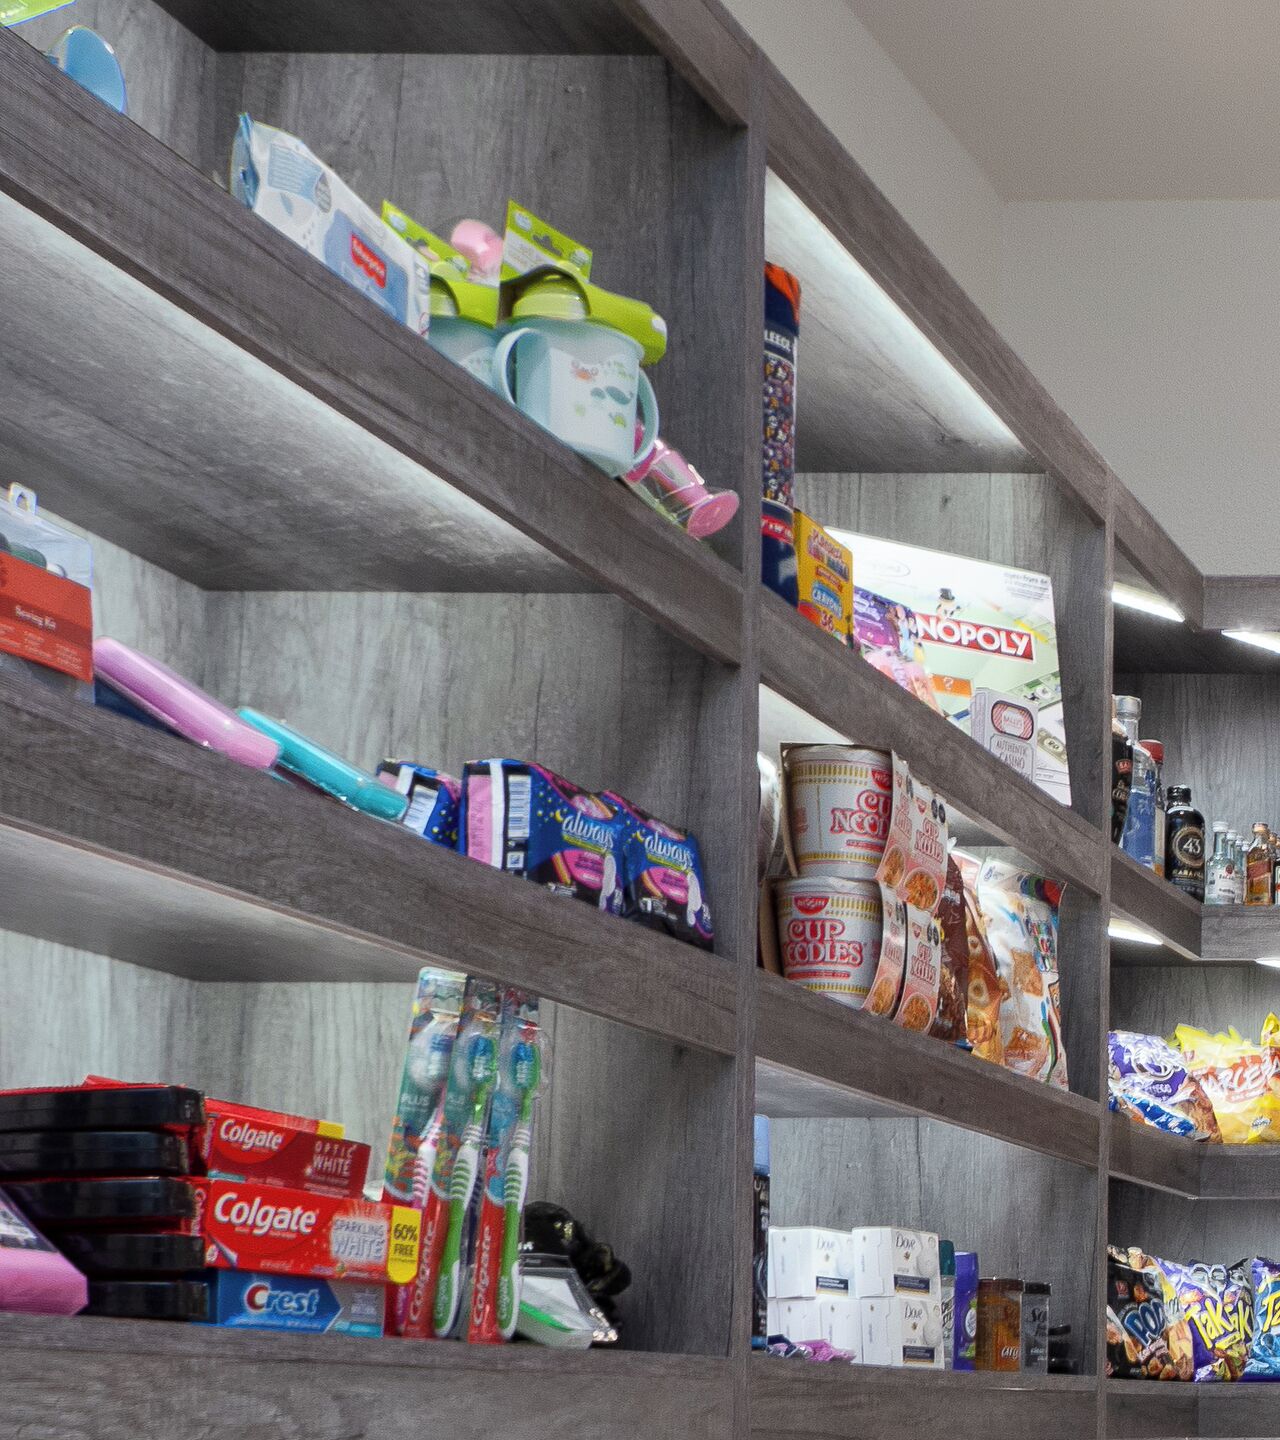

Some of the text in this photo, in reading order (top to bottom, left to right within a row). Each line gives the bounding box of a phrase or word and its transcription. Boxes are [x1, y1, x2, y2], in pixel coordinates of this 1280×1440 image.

[915, 614, 1033, 657] NOPOLY
[563, 811, 615, 852] always
[644, 831, 694, 869] always
[1183, 838, 1202, 854] 43
[789, 918, 845, 941] CUP
[219, 1118, 283, 1151] Colgate
[313, 1154, 351, 1175] WHITE
[214, 1192, 318, 1237] Colgate
[393, 1223, 417, 1243] 60%
[894, 1233, 917, 1250] Dove
[334, 1236, 386, 1261] WHITE
[393, 1244, 415, 1256] FREE
[473, 1225, 492, 1326] Colgate
[244, 1282, 320, 1317] Crest
[904, 1304, 924, 1321] Dove
